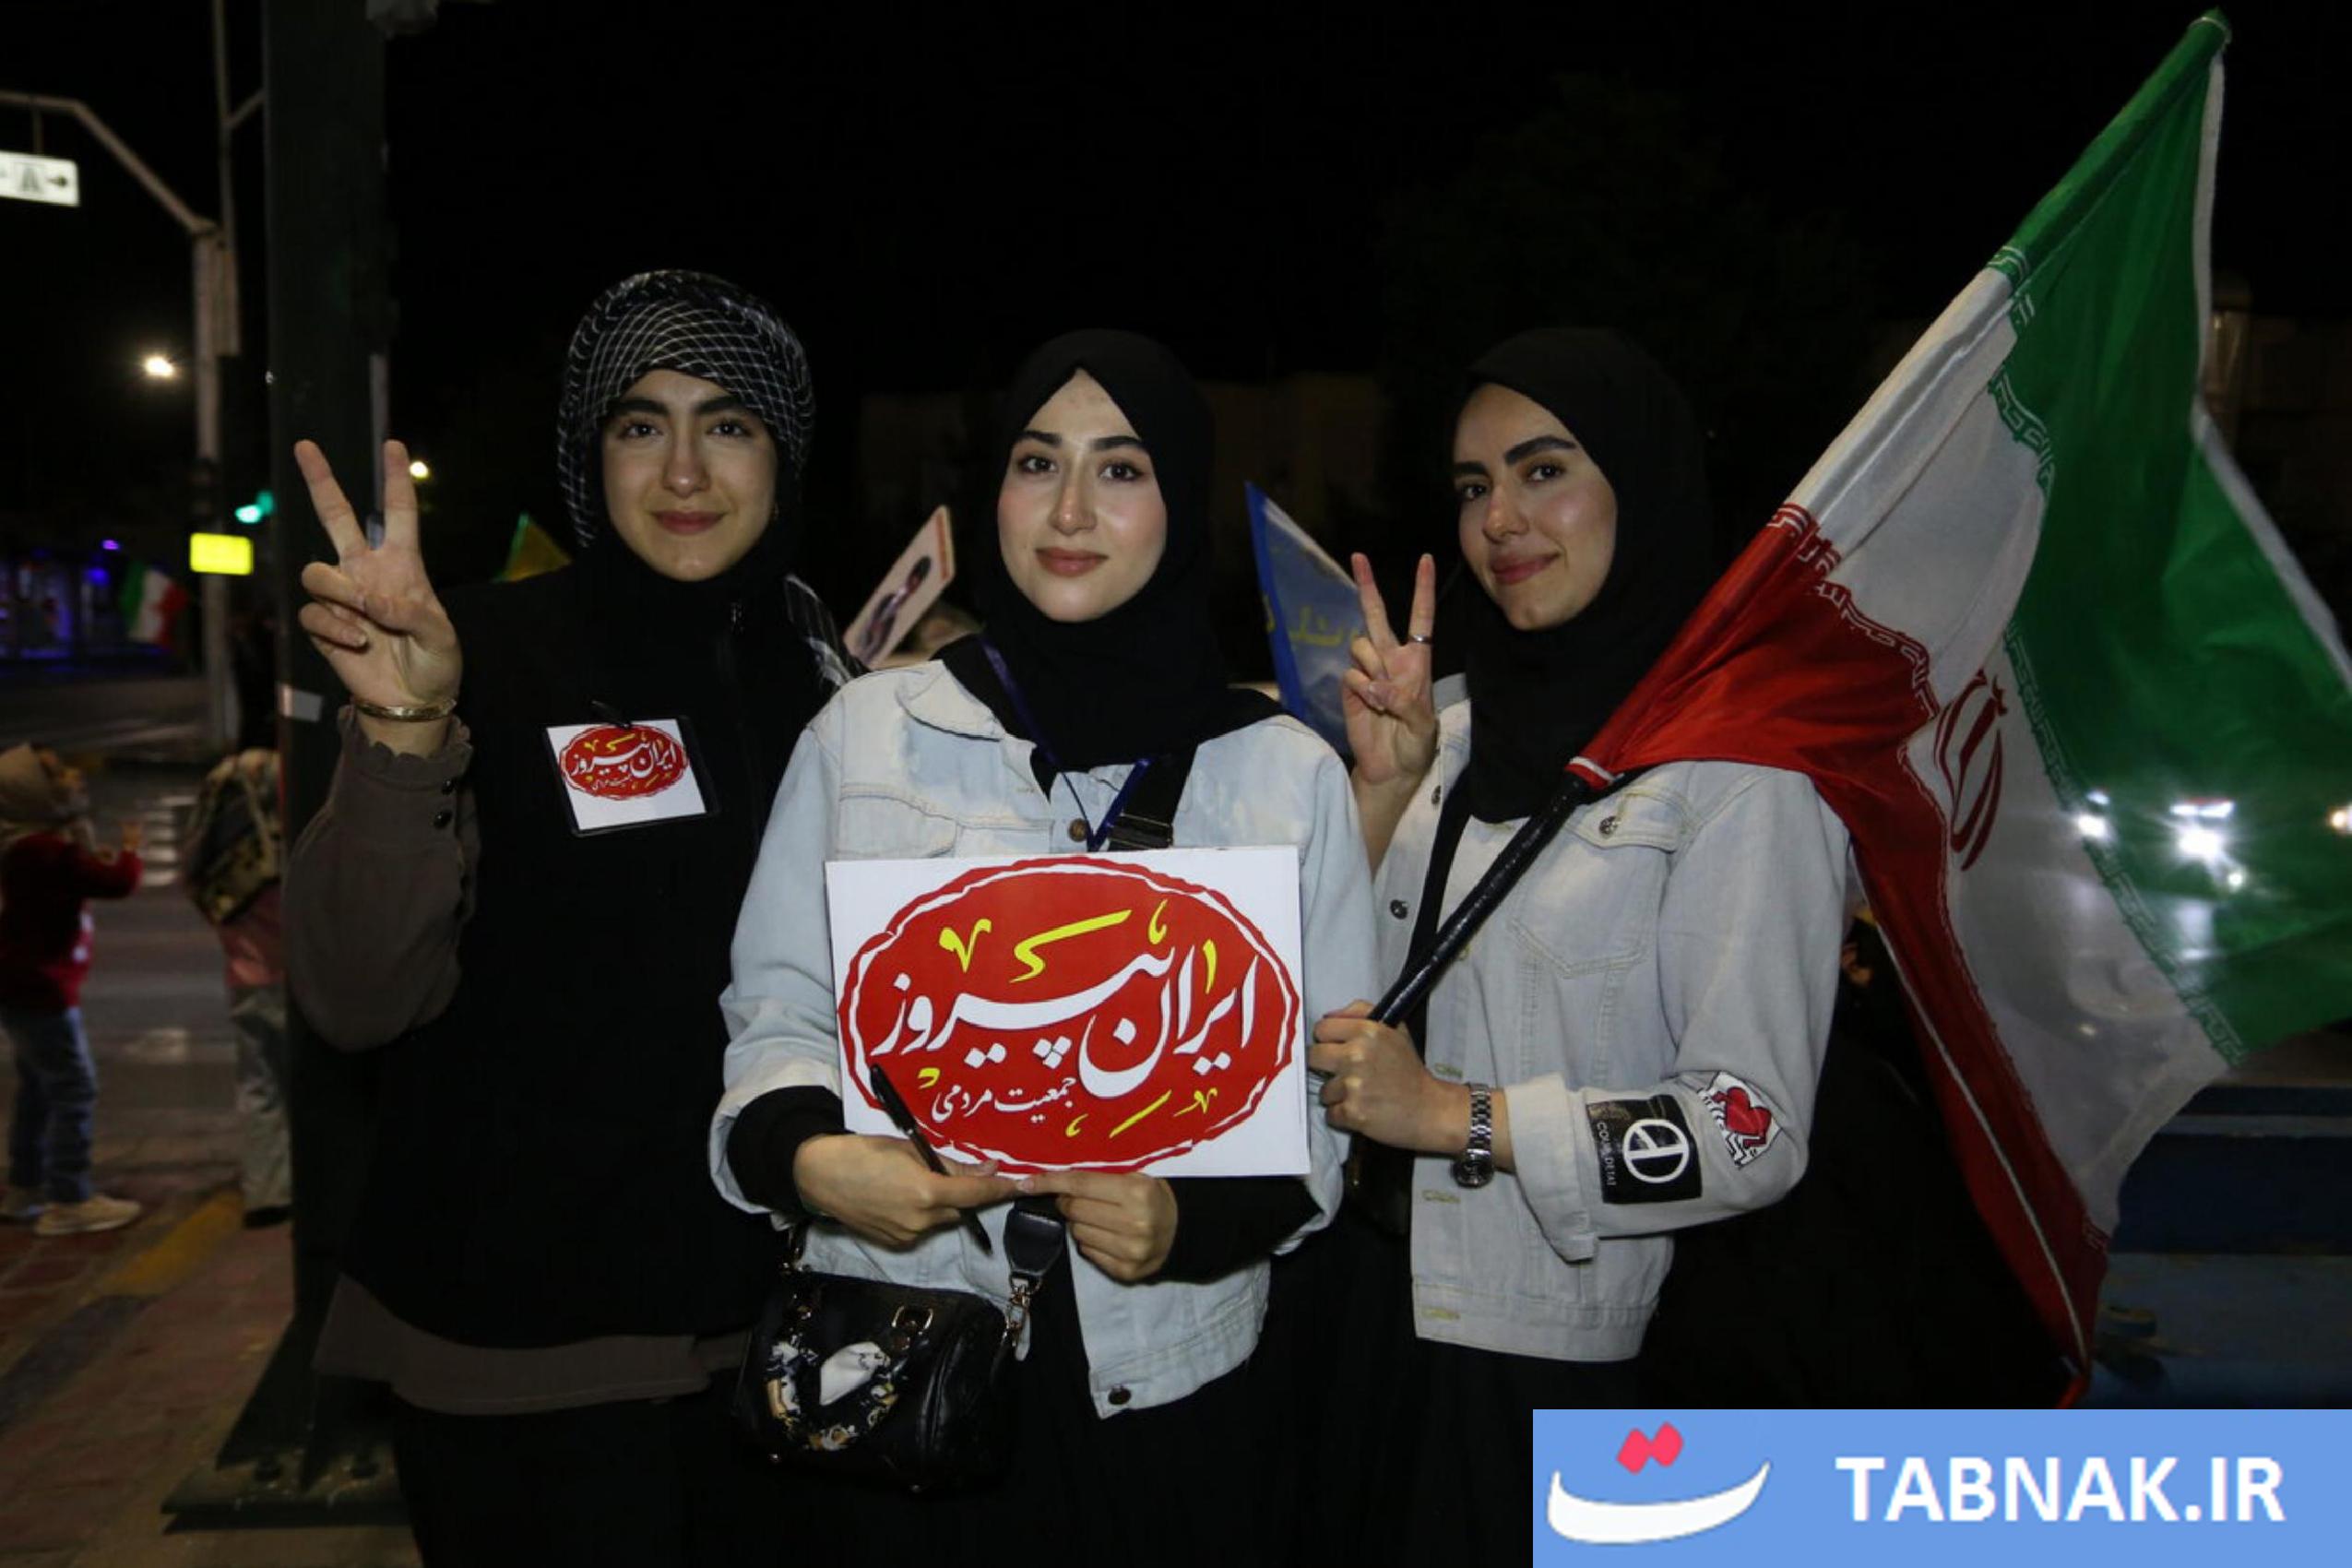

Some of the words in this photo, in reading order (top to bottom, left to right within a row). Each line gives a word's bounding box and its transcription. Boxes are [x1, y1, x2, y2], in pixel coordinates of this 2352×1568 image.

[570, 742, 651, 776] پیروز
[629, 741, 677, 778] ایران
[870, 946, 1175, 1069] پیروز
[1078, 944, 1259, 1098] ایران
[931, 1084, 993, 1123] مردمی
[994, 1075, 1077, 1123] جمعیت
